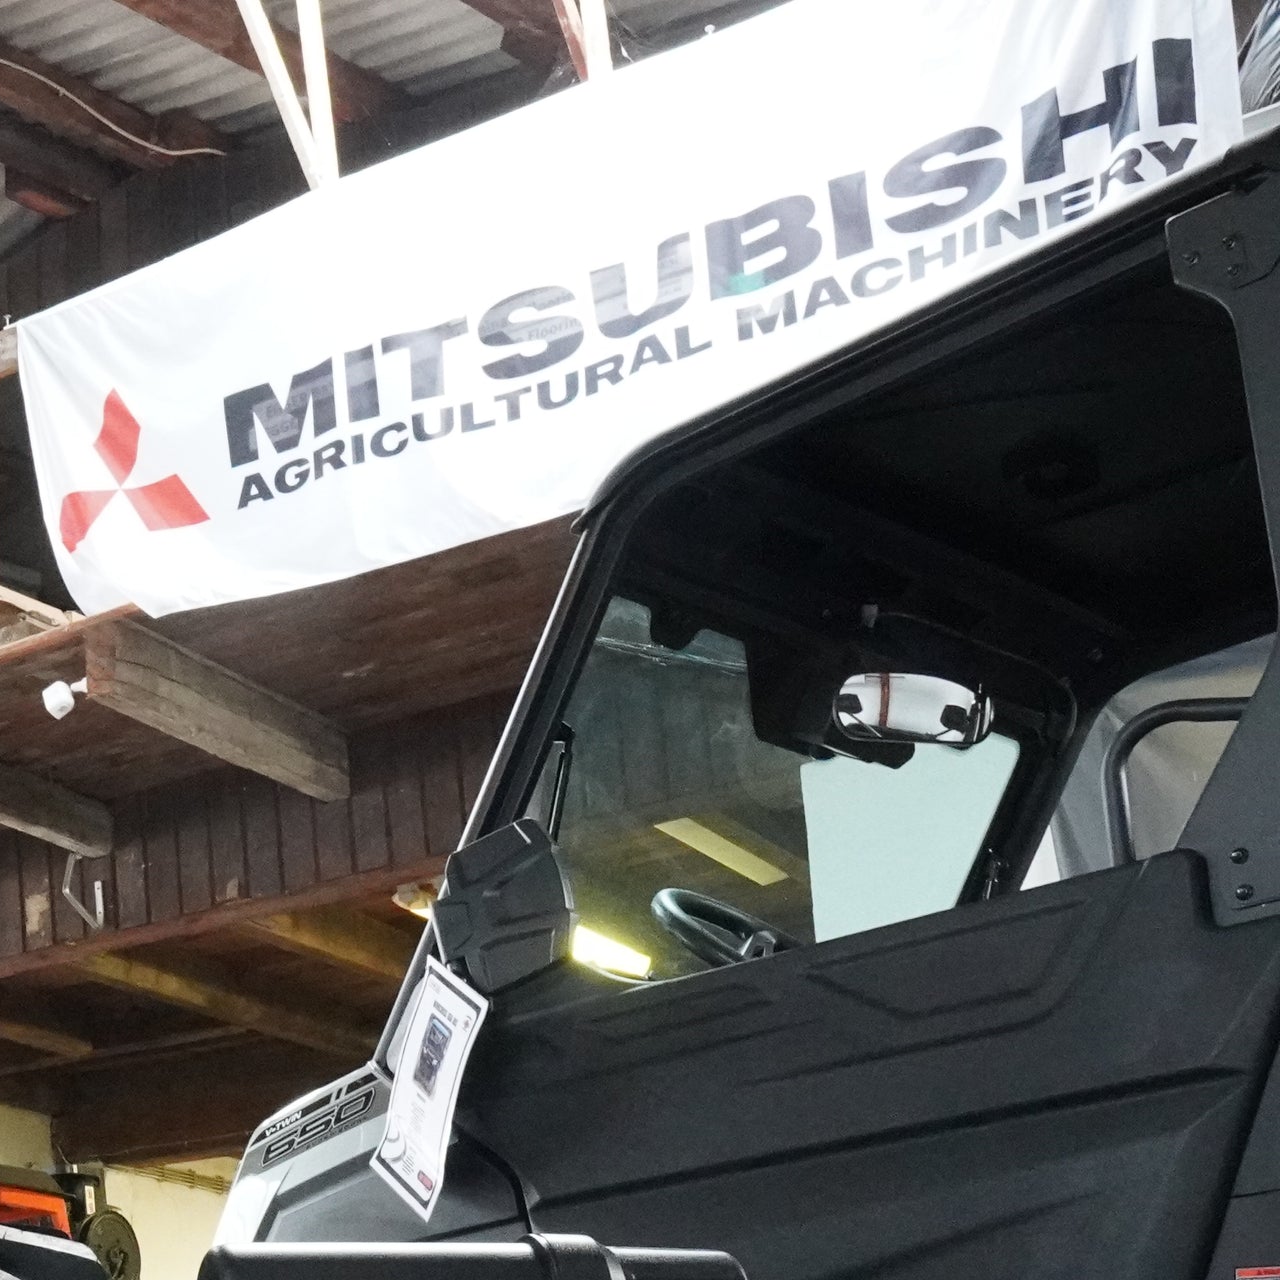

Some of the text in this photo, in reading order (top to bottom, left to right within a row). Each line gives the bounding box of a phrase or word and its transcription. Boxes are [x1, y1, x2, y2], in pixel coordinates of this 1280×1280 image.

[223, 37, 1198, 468] MITSUBISHI
[236, 137, 1198, 510] AGRICULTURAL MACHINERY
[262, 1087, 376, 1168] 650
[264, 1110, 302, 1136] V-TWIN
